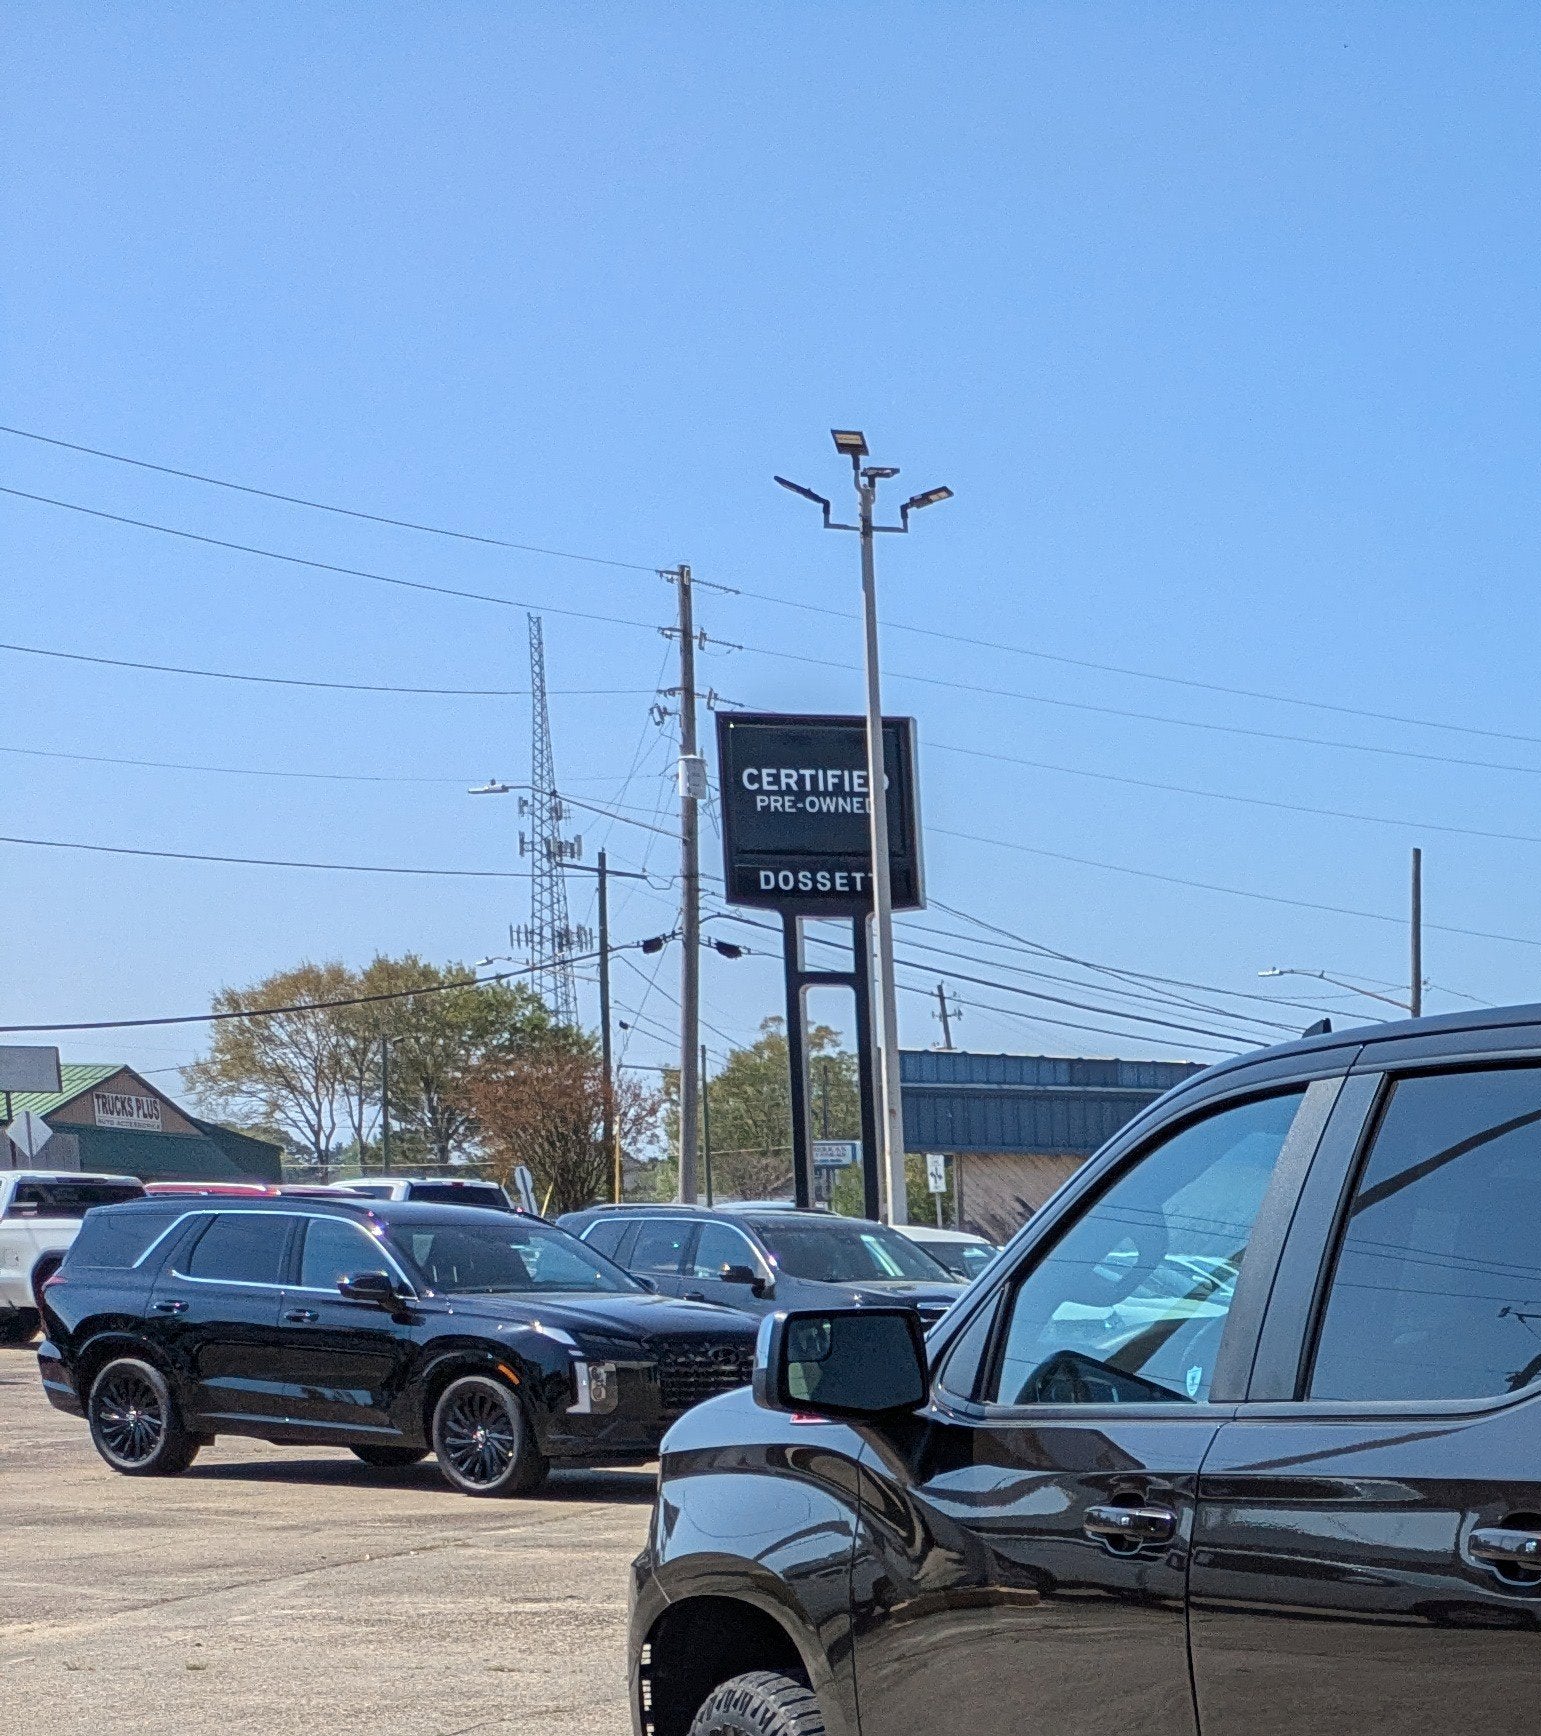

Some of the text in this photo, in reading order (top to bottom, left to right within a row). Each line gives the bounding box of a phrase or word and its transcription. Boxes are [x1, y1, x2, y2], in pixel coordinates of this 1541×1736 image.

[742, 768, 889, 793] CERTIFIE
[95, 1093, 160, 1120] TRUCKS PLUS
